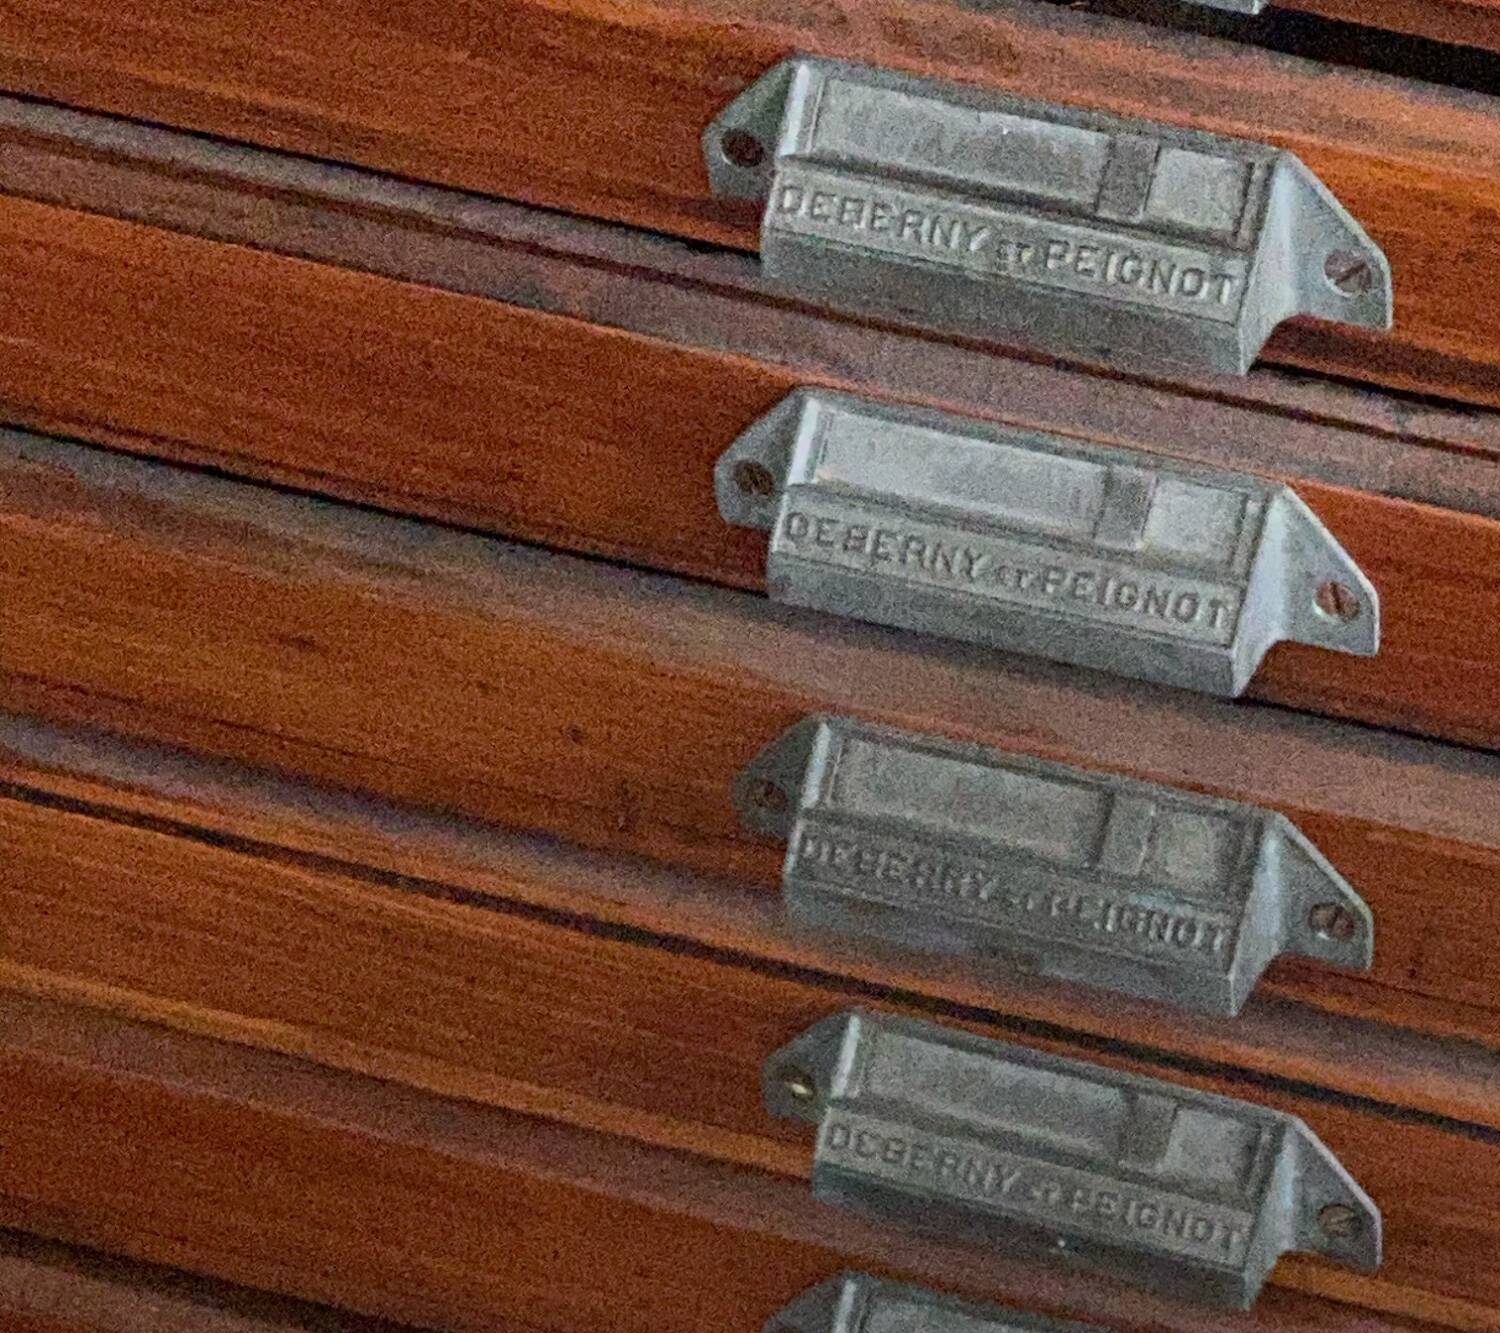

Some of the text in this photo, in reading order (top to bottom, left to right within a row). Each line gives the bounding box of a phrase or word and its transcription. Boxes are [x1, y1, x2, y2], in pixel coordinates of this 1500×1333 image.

[776, 182, 990, 256] DEBERNY
[1042, 236, 1240, 306] PEIGNOT
[781, 510, 992, 583] DEBERNY
[1041, 564, 1233, 629] PEIGNOT
